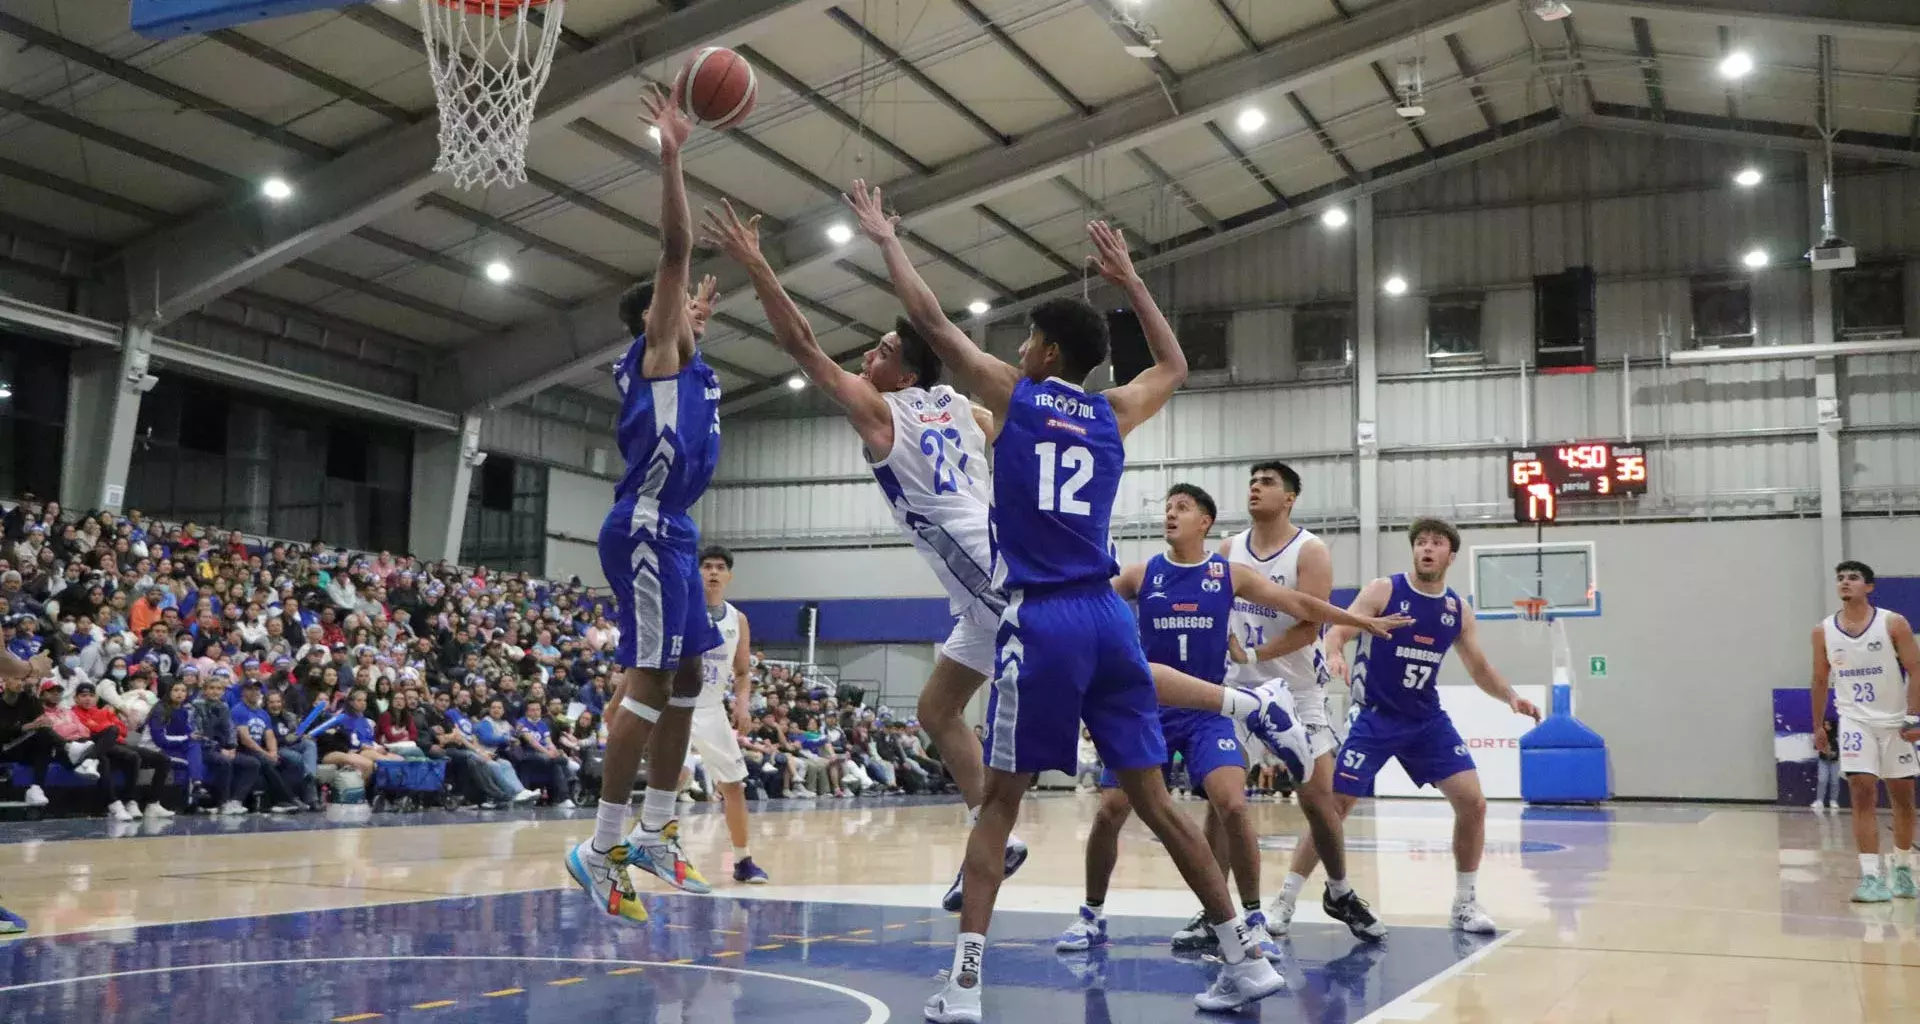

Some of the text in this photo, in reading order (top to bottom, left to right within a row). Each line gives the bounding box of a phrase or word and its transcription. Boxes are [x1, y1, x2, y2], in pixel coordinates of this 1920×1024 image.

[1035, 394, 1096, 419] TEC TOL
[1558, 445, 1607, 468] 4:50
[1616, 456, 1645, 480] 35
[1035, 441, 1094, 516] 12
[1562, 475, 1610, 494] period 3
[1153, 616, 1214, 629] BORREGOS
[1243, 622, 1264, 648] 21
[1177, 633, 1188, 661] 1
[1402, 663, 1432, 690] 57
[1852, 682, 1875, 702] 23
[1842, 731, 1863, 751] 23
[1343, 749, 1366, 770] 57
